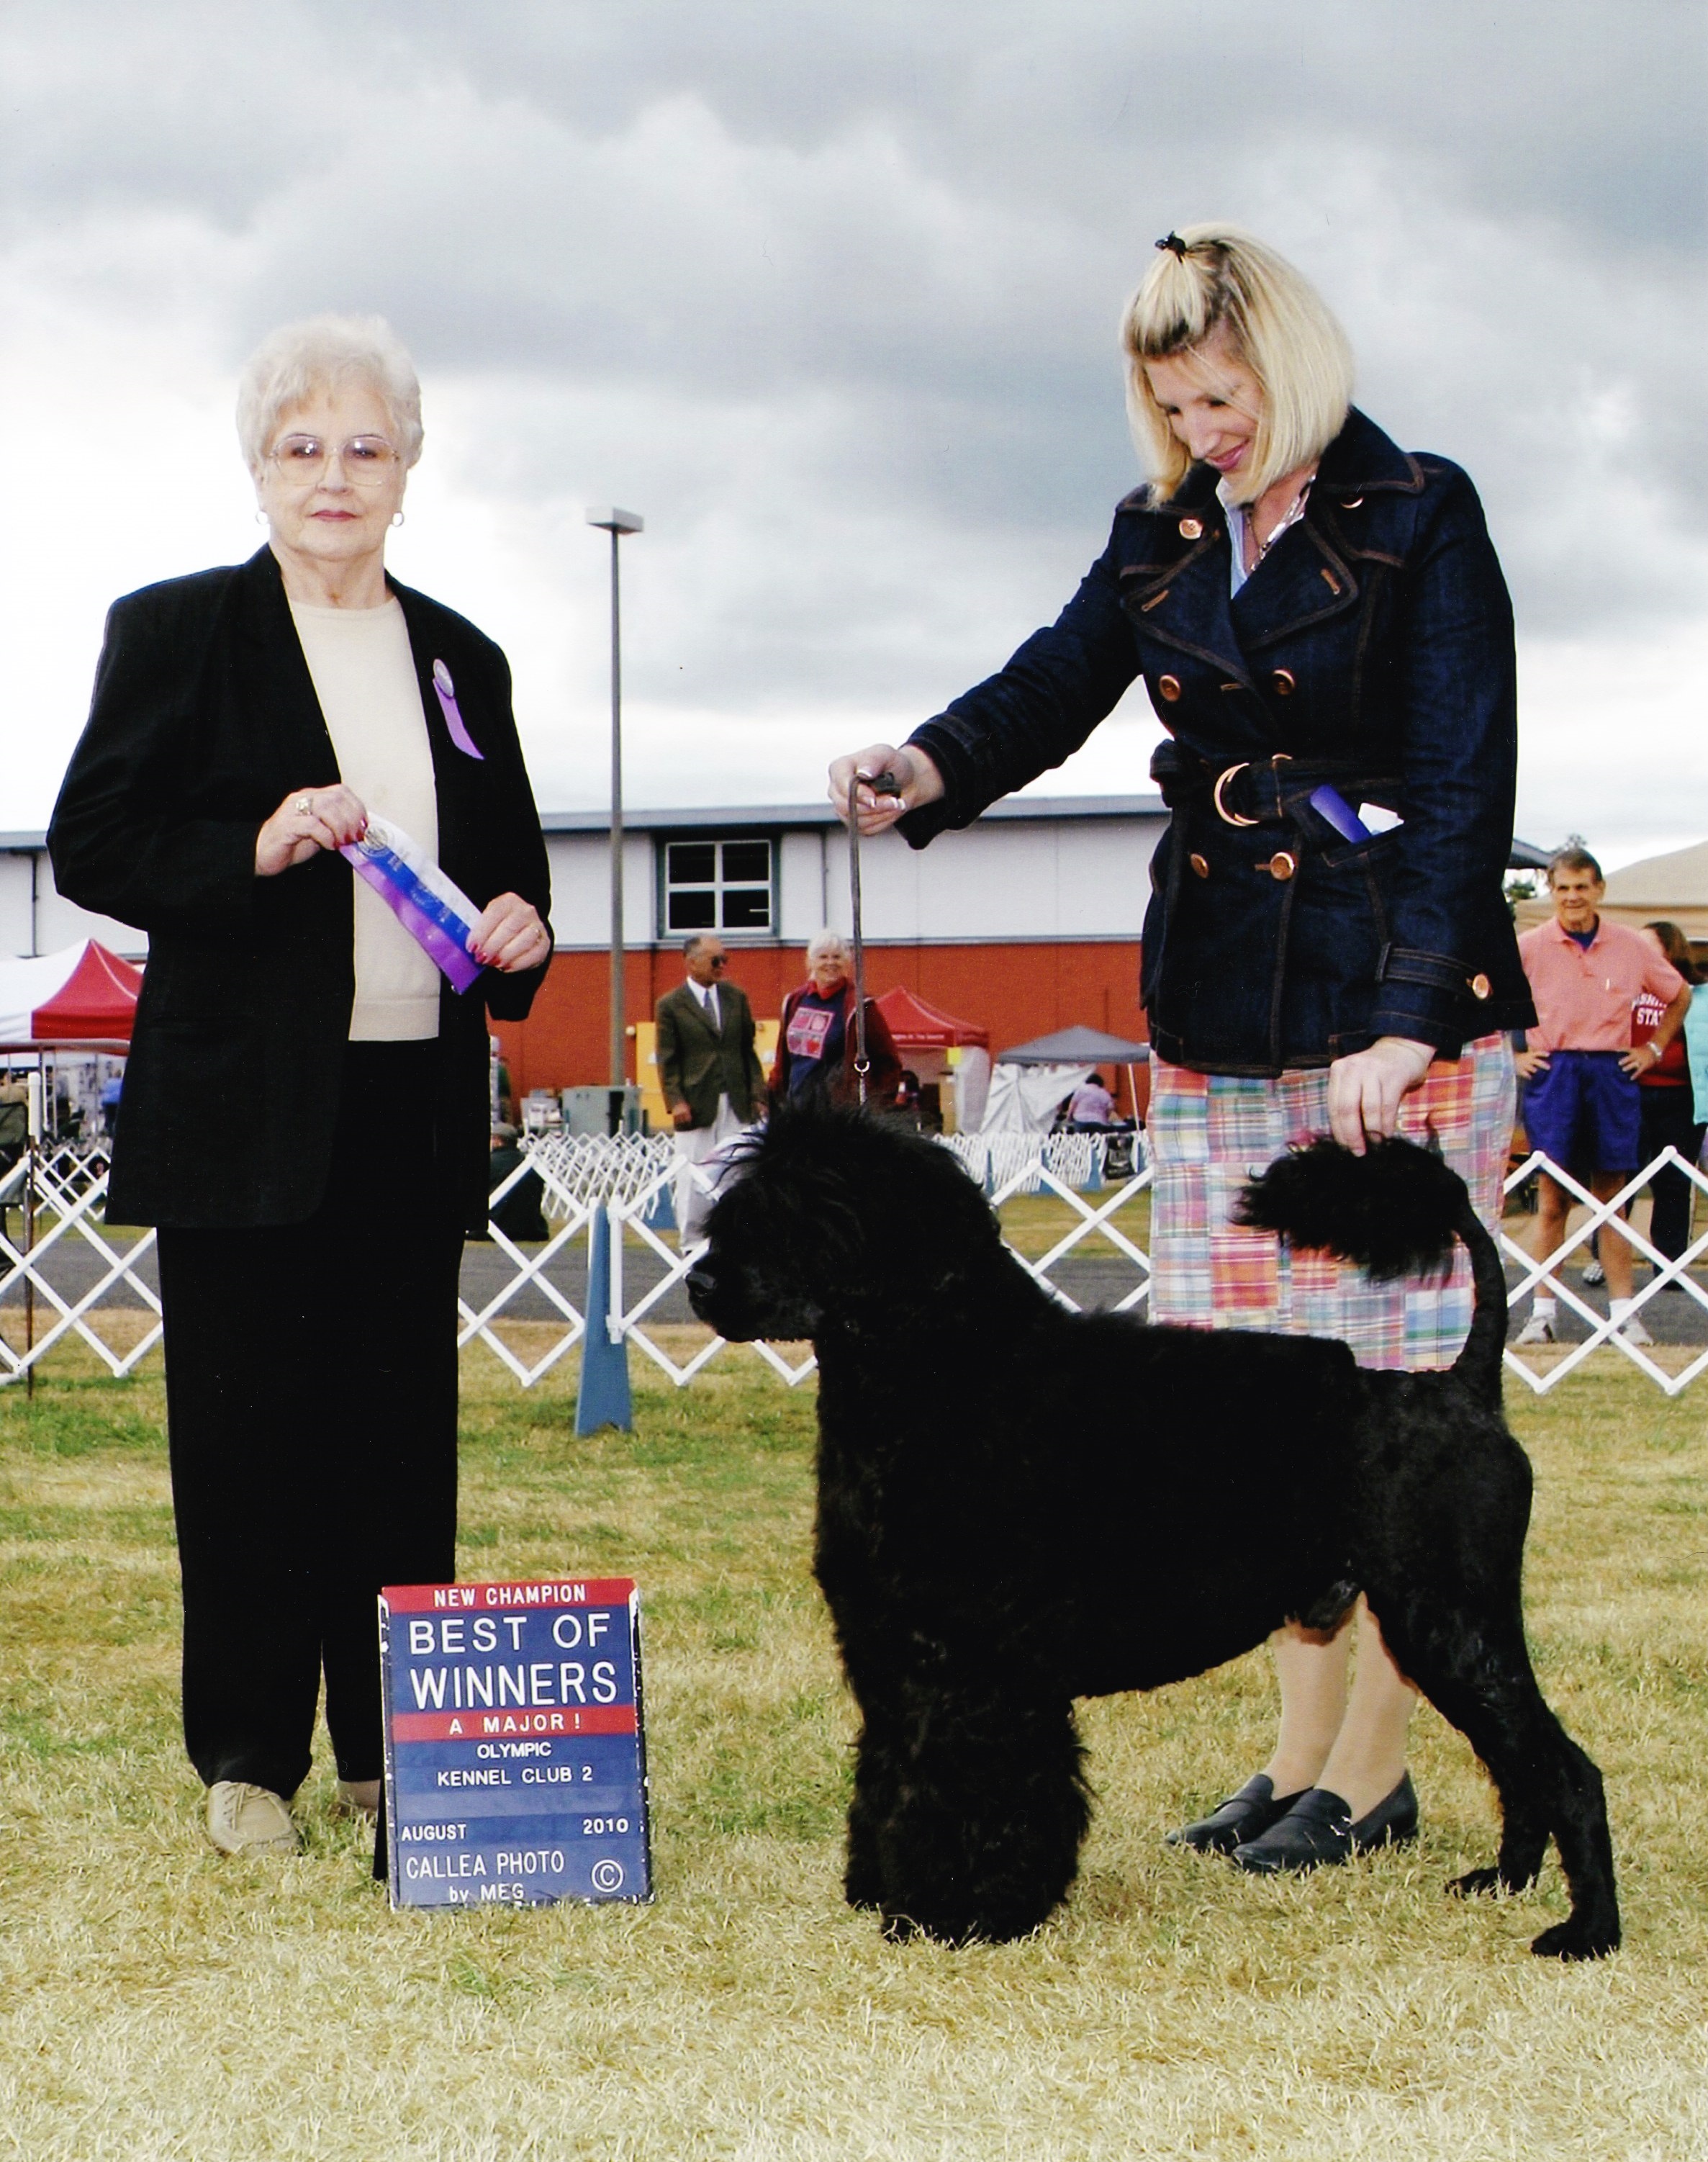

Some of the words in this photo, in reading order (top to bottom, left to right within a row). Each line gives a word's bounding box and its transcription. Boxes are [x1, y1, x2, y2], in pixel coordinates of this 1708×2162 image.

[434, 1588, 475, 1608] NEW
[486, 1584, 585, 1605] CHAMPION
[410, 1613, 527, 1655] BEST
[553, 1613, 610, 1648] OF
[410, 1662, 617, 1710] WINNERS
[449, 1718, 463, 1735] A
[477, 1742, 551, 1759] OLYMPIC
[438, 1769, 512, 1787] KENNEL
[522, 1767, 572, 1783] CLUB
[582, 1766, 593, 1782] 2
[401, 1824, 466, 1842] AUGUST
[583, 1818, 628, 1834] 2010
[406, 1854, 487, 1879] CALLEA
[497, 1850, 564, 1874] PHOTO
[448, 1886, 469, 1903] by
[480, 1883, 524, 1901] MEG
